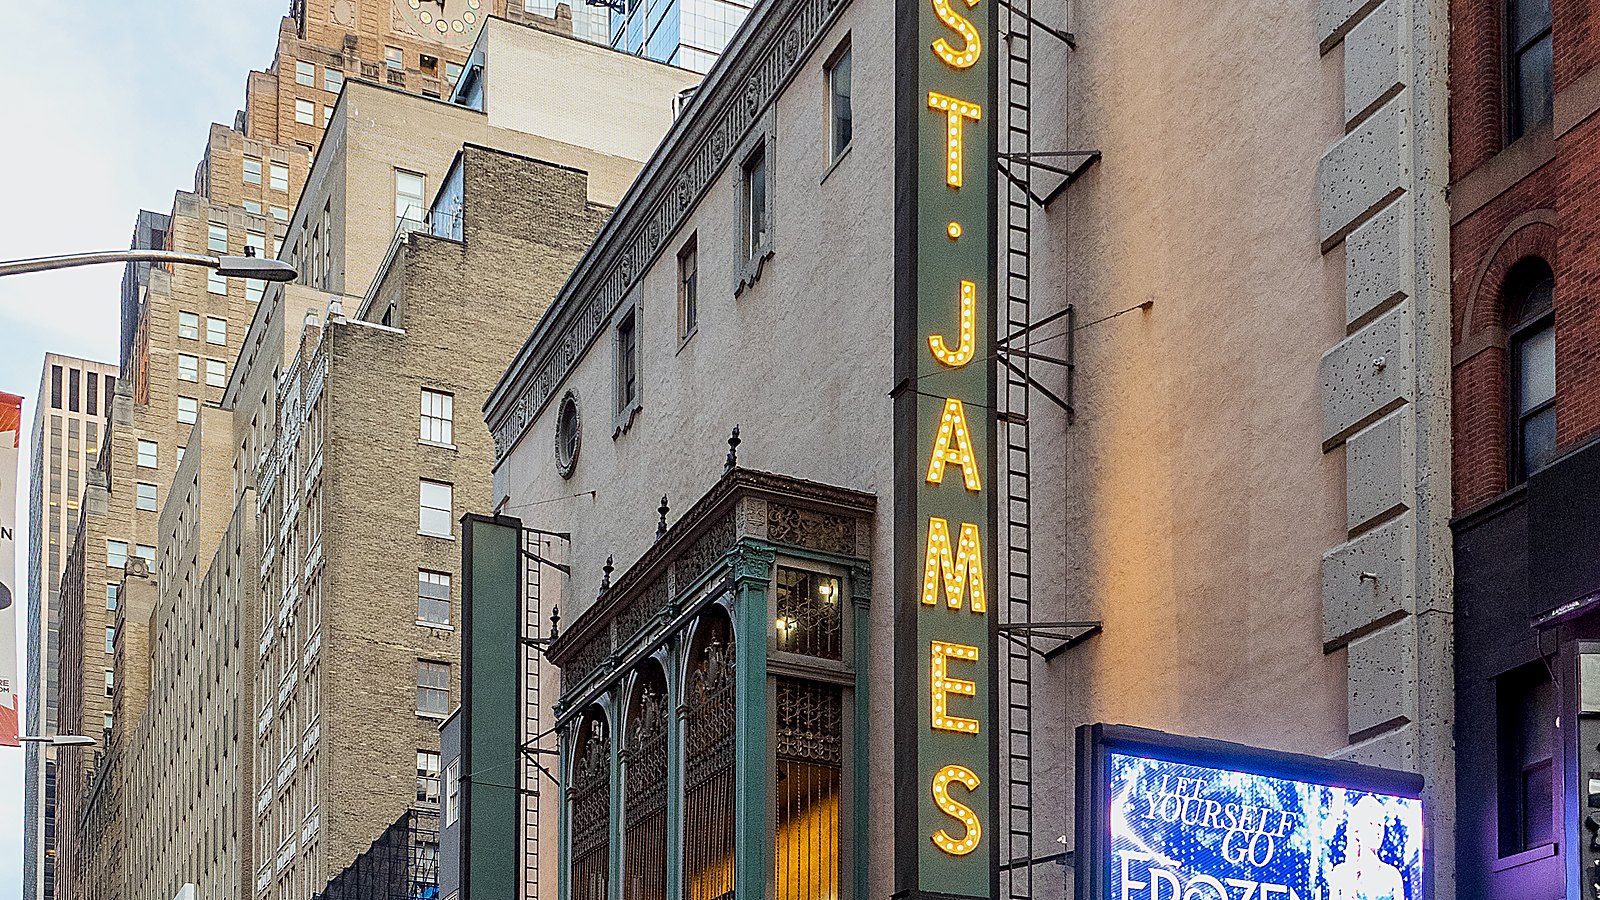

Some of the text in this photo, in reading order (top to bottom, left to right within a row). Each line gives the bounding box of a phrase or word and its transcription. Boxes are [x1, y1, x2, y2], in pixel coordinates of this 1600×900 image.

[921, 279, 987, 856] JAMES
[1156, 774, 1208, 800] LET
[1143, 789, 1298, 838] YOURSELF
[1221, 829, 1275, 868] GO
